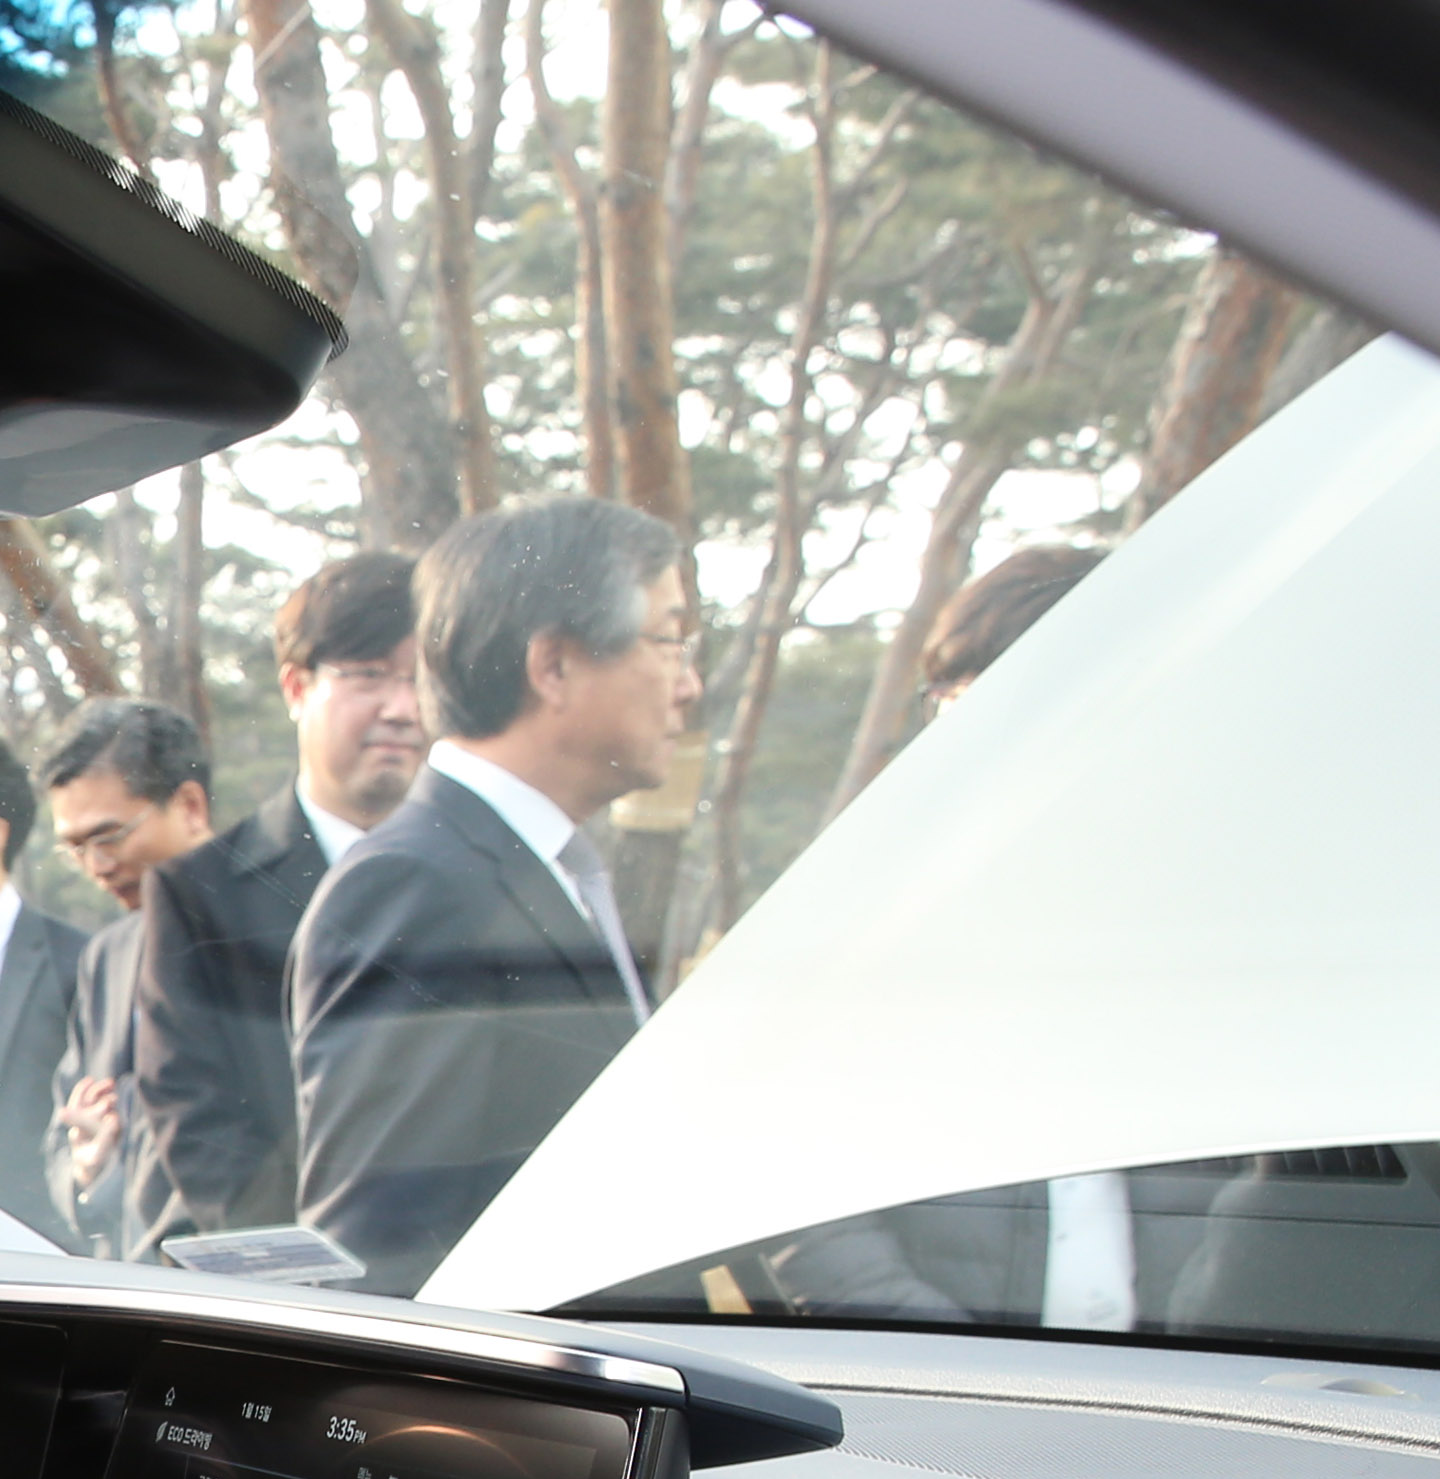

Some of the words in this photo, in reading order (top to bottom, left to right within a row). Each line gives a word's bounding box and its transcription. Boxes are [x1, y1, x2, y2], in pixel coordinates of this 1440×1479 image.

[241, 1402, 252, 1420] 1월
[253, 1404, 273, 1423] 15일
[166, 1425, 183, 1443] ECO
[182, 1428, 213, 1450] 드라이빙
